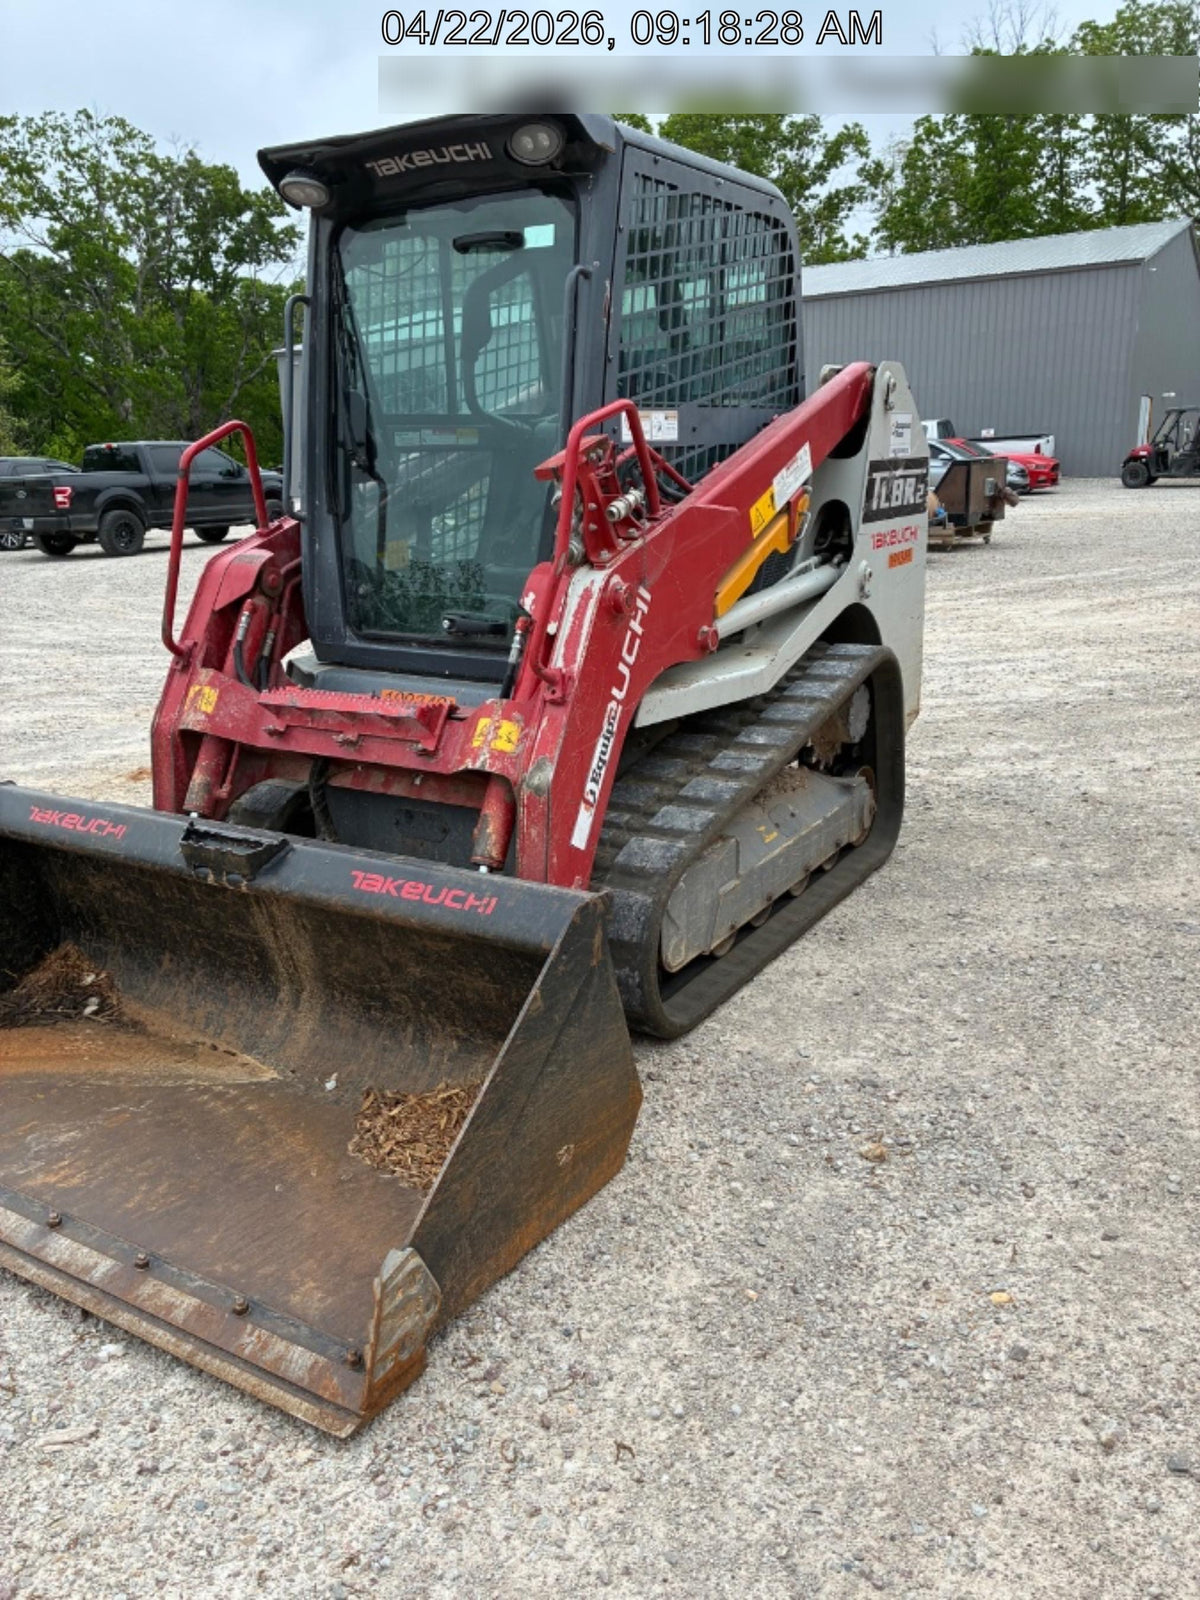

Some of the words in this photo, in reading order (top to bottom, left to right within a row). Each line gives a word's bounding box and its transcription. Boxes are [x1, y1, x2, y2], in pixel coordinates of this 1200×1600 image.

[365, 142, 493, 177] TAKEUCHI
[29, 805, 128, 840] TAKEUCHI
[350, 869, 499, 915] TAKEUCHI
